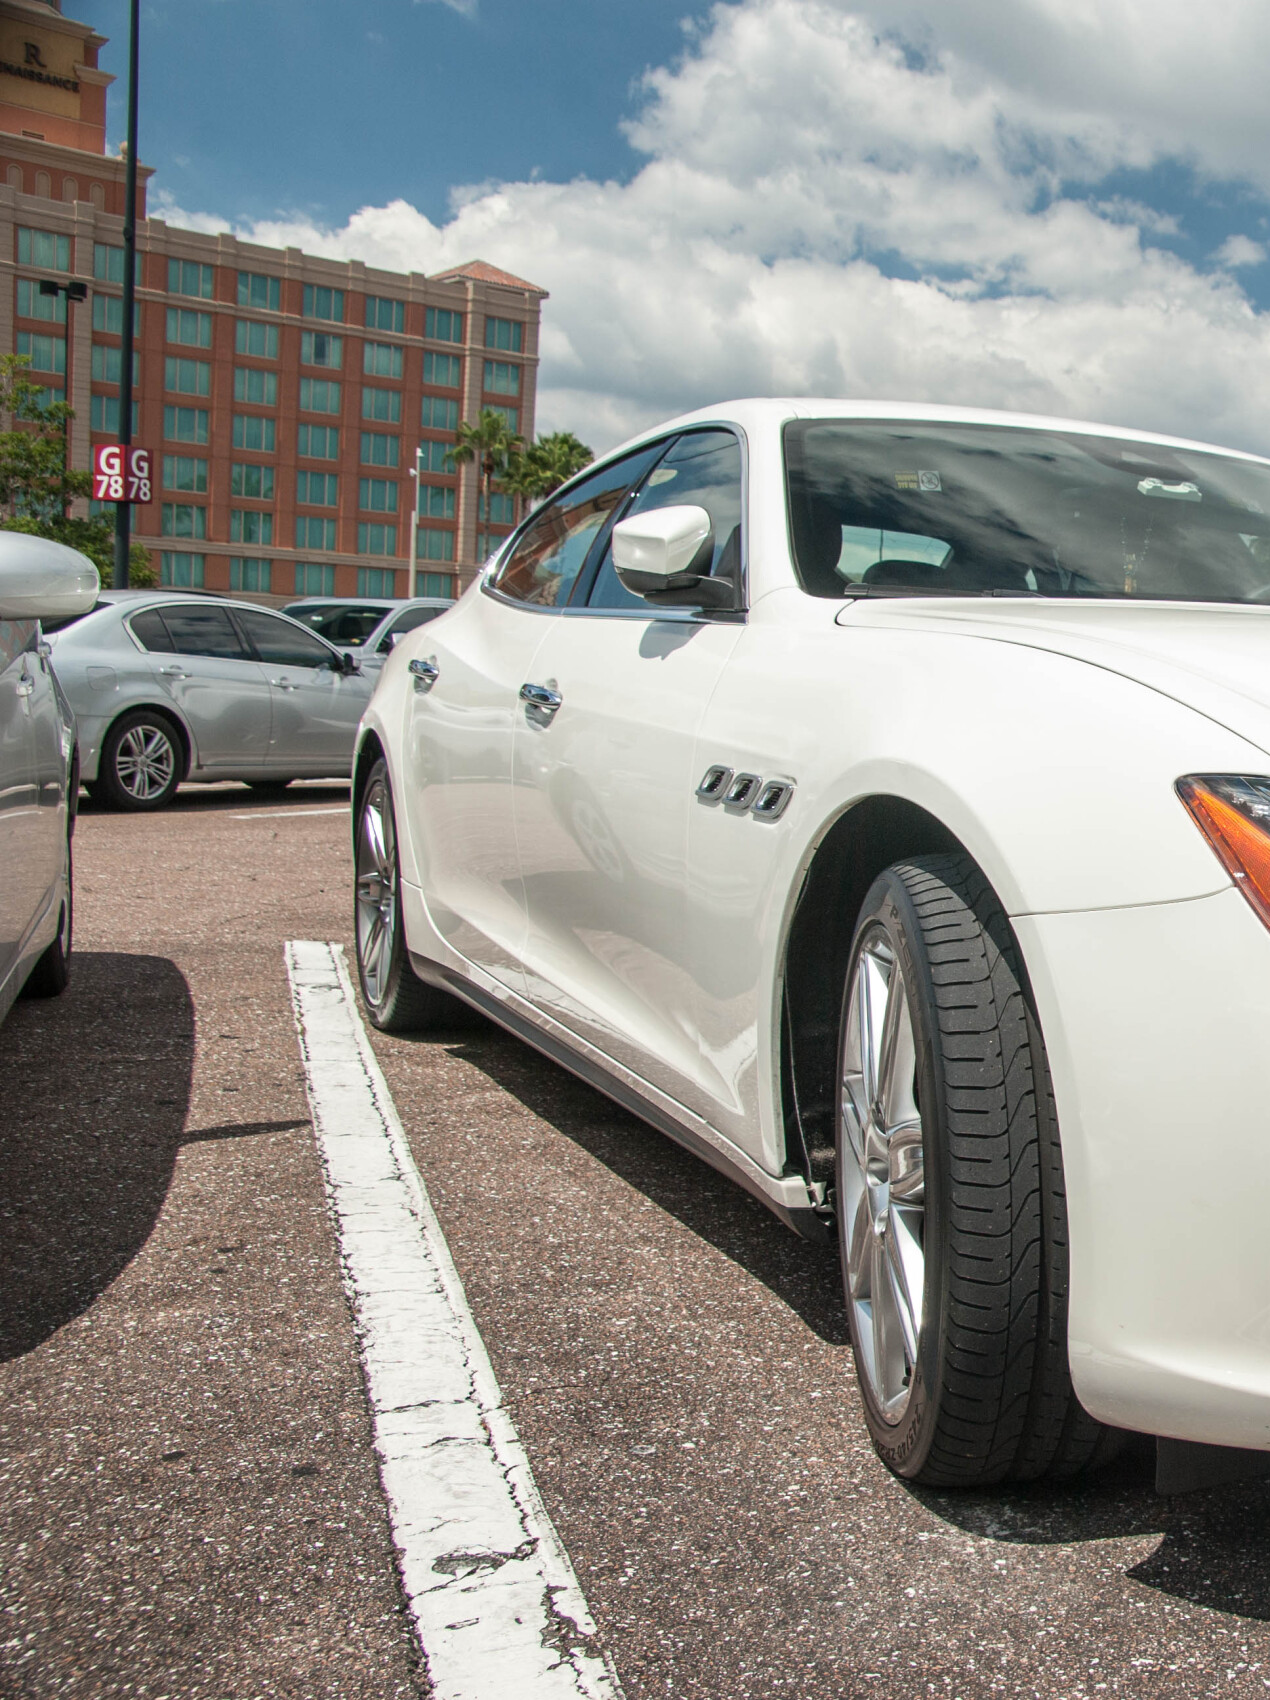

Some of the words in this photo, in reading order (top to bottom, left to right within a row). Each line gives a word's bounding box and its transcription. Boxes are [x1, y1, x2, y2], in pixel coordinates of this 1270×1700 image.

[24, 42, 47, 68] R
[99, 446, 121, 475] G
[131, 449, 149, 478] G
[96, 475, 123, 498] 78
[128, 476, 151, 501] 78
